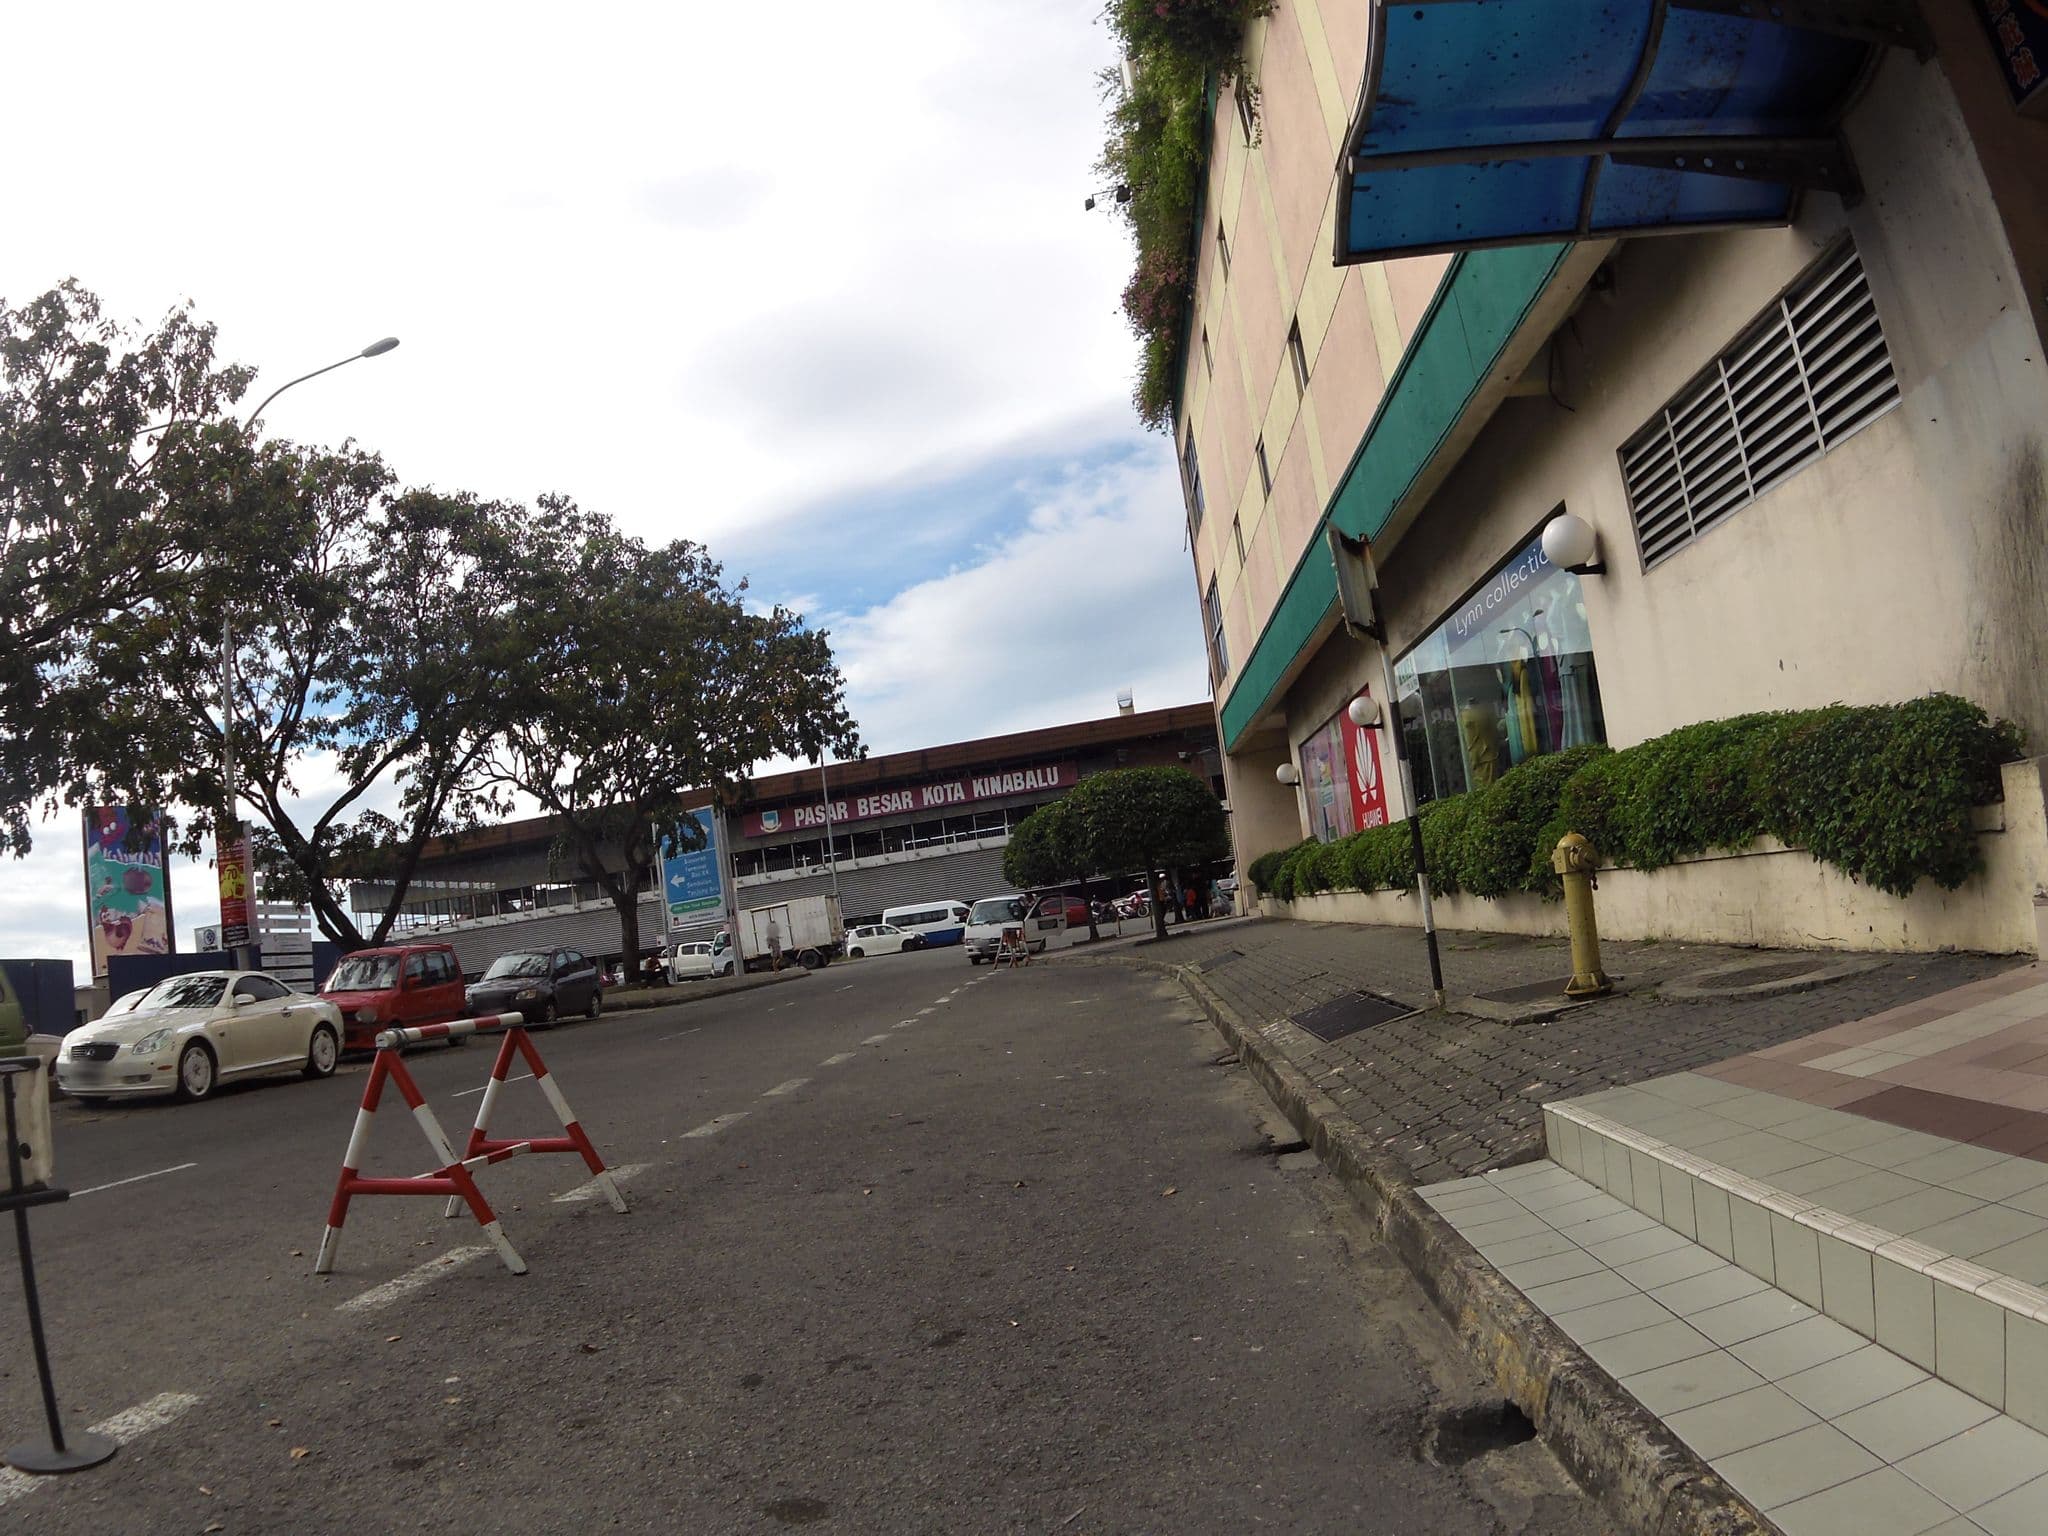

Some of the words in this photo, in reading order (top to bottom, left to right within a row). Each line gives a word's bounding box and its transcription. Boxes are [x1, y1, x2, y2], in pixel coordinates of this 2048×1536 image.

[1454, 603, 1483, 636] Lynn
[1485, 548, 1549, 609] collectio
[793, 803, 849, 828] PASAR
[857, 790, 914, 817] BESAR
[921, 782, 966, 807] KOTA
[972, 766, 1059, 798] KINABALU
[1362, 807, 1383, 829] HUAWEI
